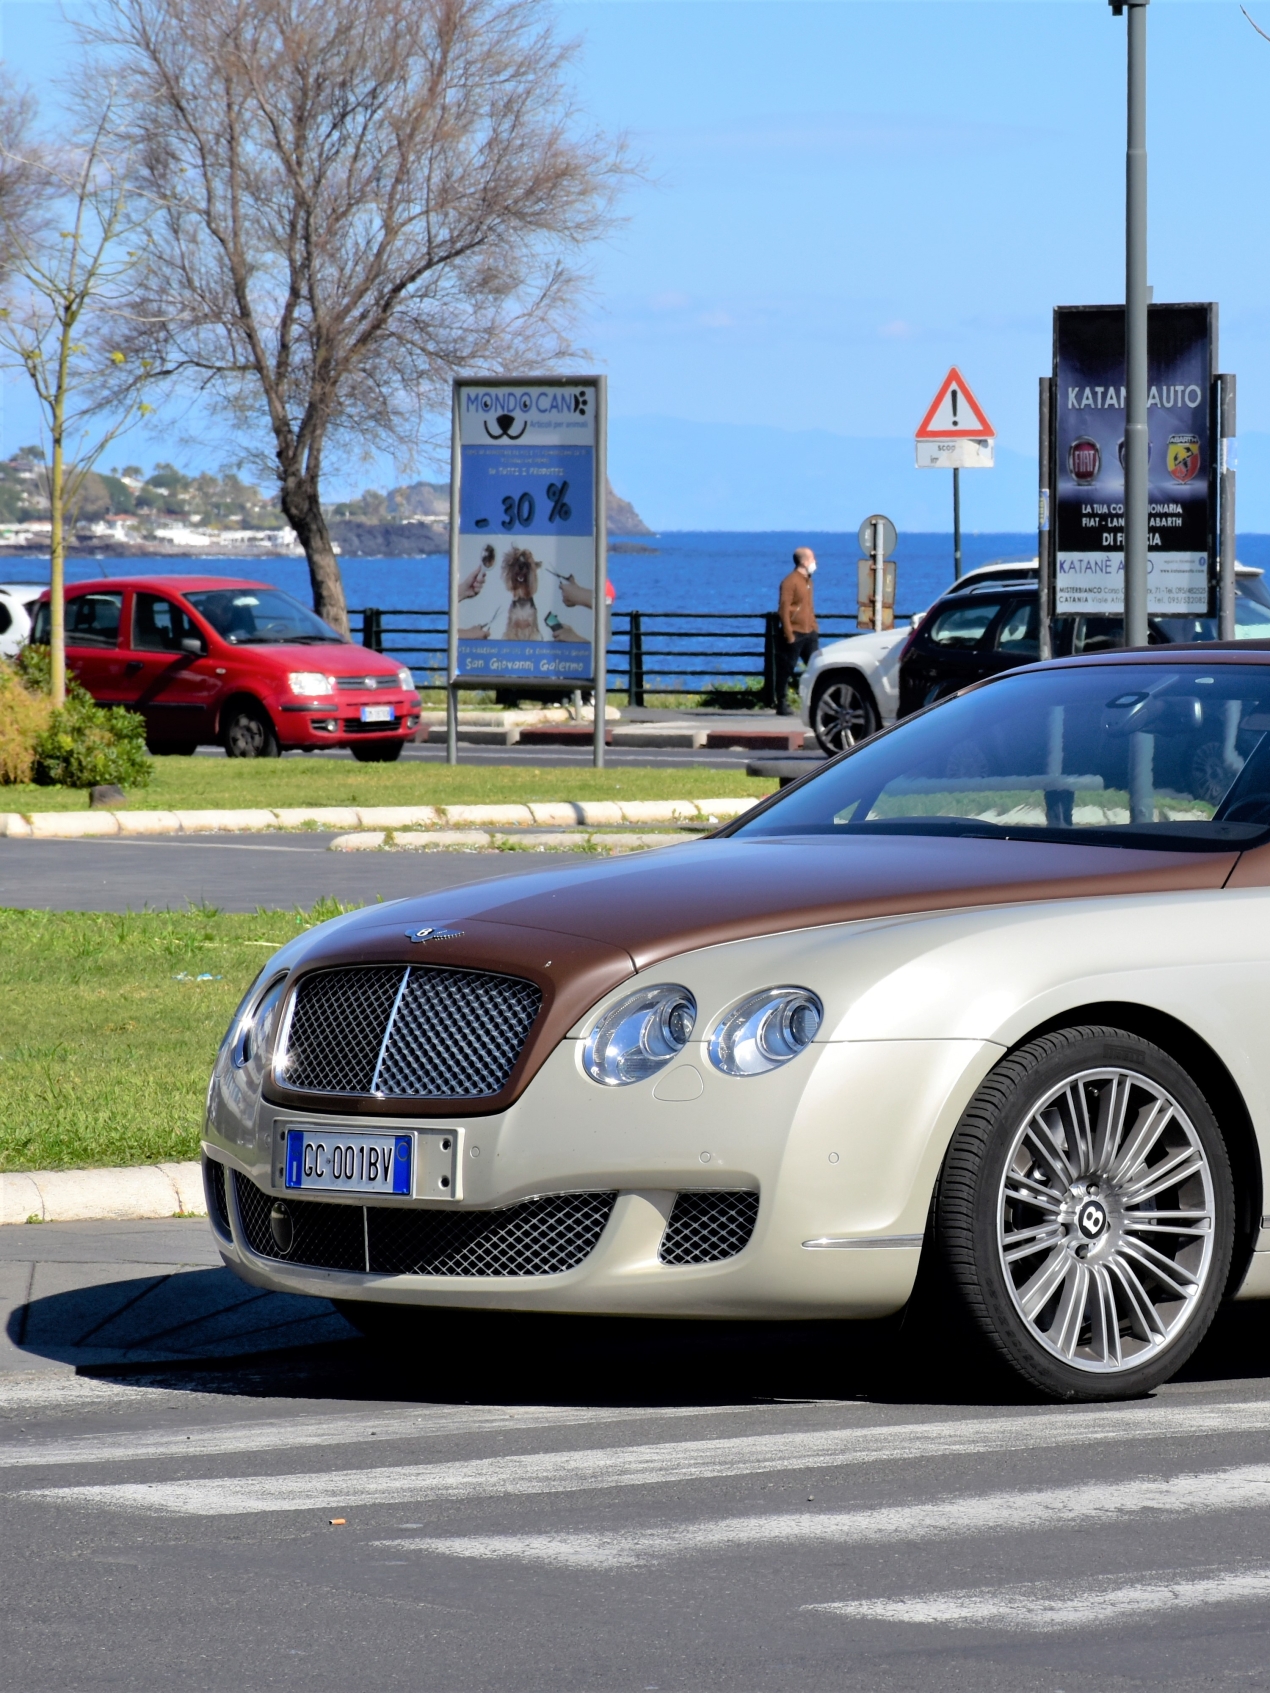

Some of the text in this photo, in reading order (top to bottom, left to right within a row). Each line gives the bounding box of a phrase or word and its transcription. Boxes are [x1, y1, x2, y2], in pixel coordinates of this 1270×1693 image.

[466, 391, 533, 413] MONDO
[1146, 385, 1202, 408] AUTO
[554, 421, 564, 430] per
[565, 421, 589, 429] animali
[1169, 435, 1198, 443] ABARTH
[1074, 450, 1095, 472] FIAT
[501, 491, 536, 531] 30
[546, 480, 572, 524] %
[1082, 504, 1092, 513] LA
[1093, 504, 1108, 513] TUA
[1082, 518, 1099, 527] FIAT
[1149, 517, 1182, 527] ABARTH
[1102, 533, 1113, 546] DI
[1059, 555, 1112, 574] KATANÈ
[1059, 596, 1089, 604] CATANIA
[1091, 596, 1107, 604] Viale
[466, 658, 584, 671] San Giovanni Galermo
